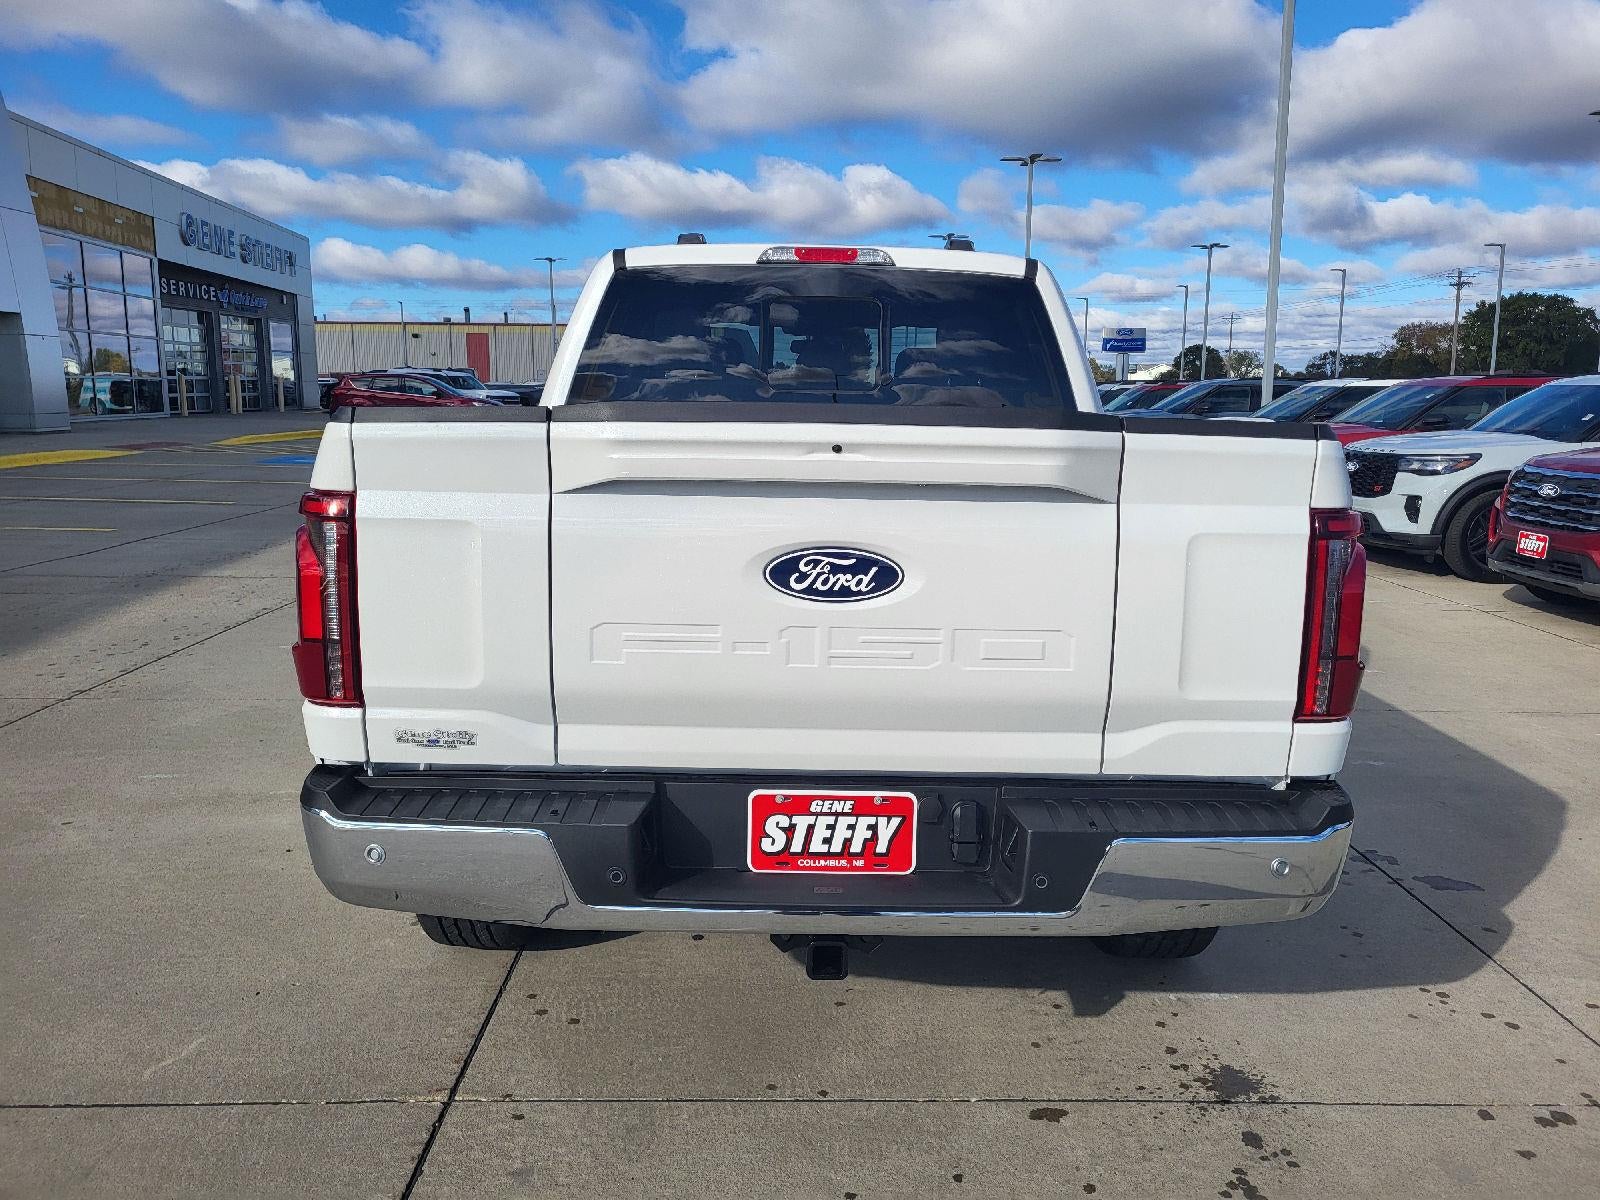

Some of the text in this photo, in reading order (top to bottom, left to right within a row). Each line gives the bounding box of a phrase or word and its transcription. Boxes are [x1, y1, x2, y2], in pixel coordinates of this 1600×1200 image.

[179, 211, 297, 277] GENE STEFFY
[160, 277, 217, 301] SERVICE
[789, 556, 878, 592] Ford
[590, 622, 1076, 671] F-150
[809, 800, 855, 813] GENE
[760, 814, 905, 856] STEFFY
[797, 859, 865, 869] COLUMBUS, NE
